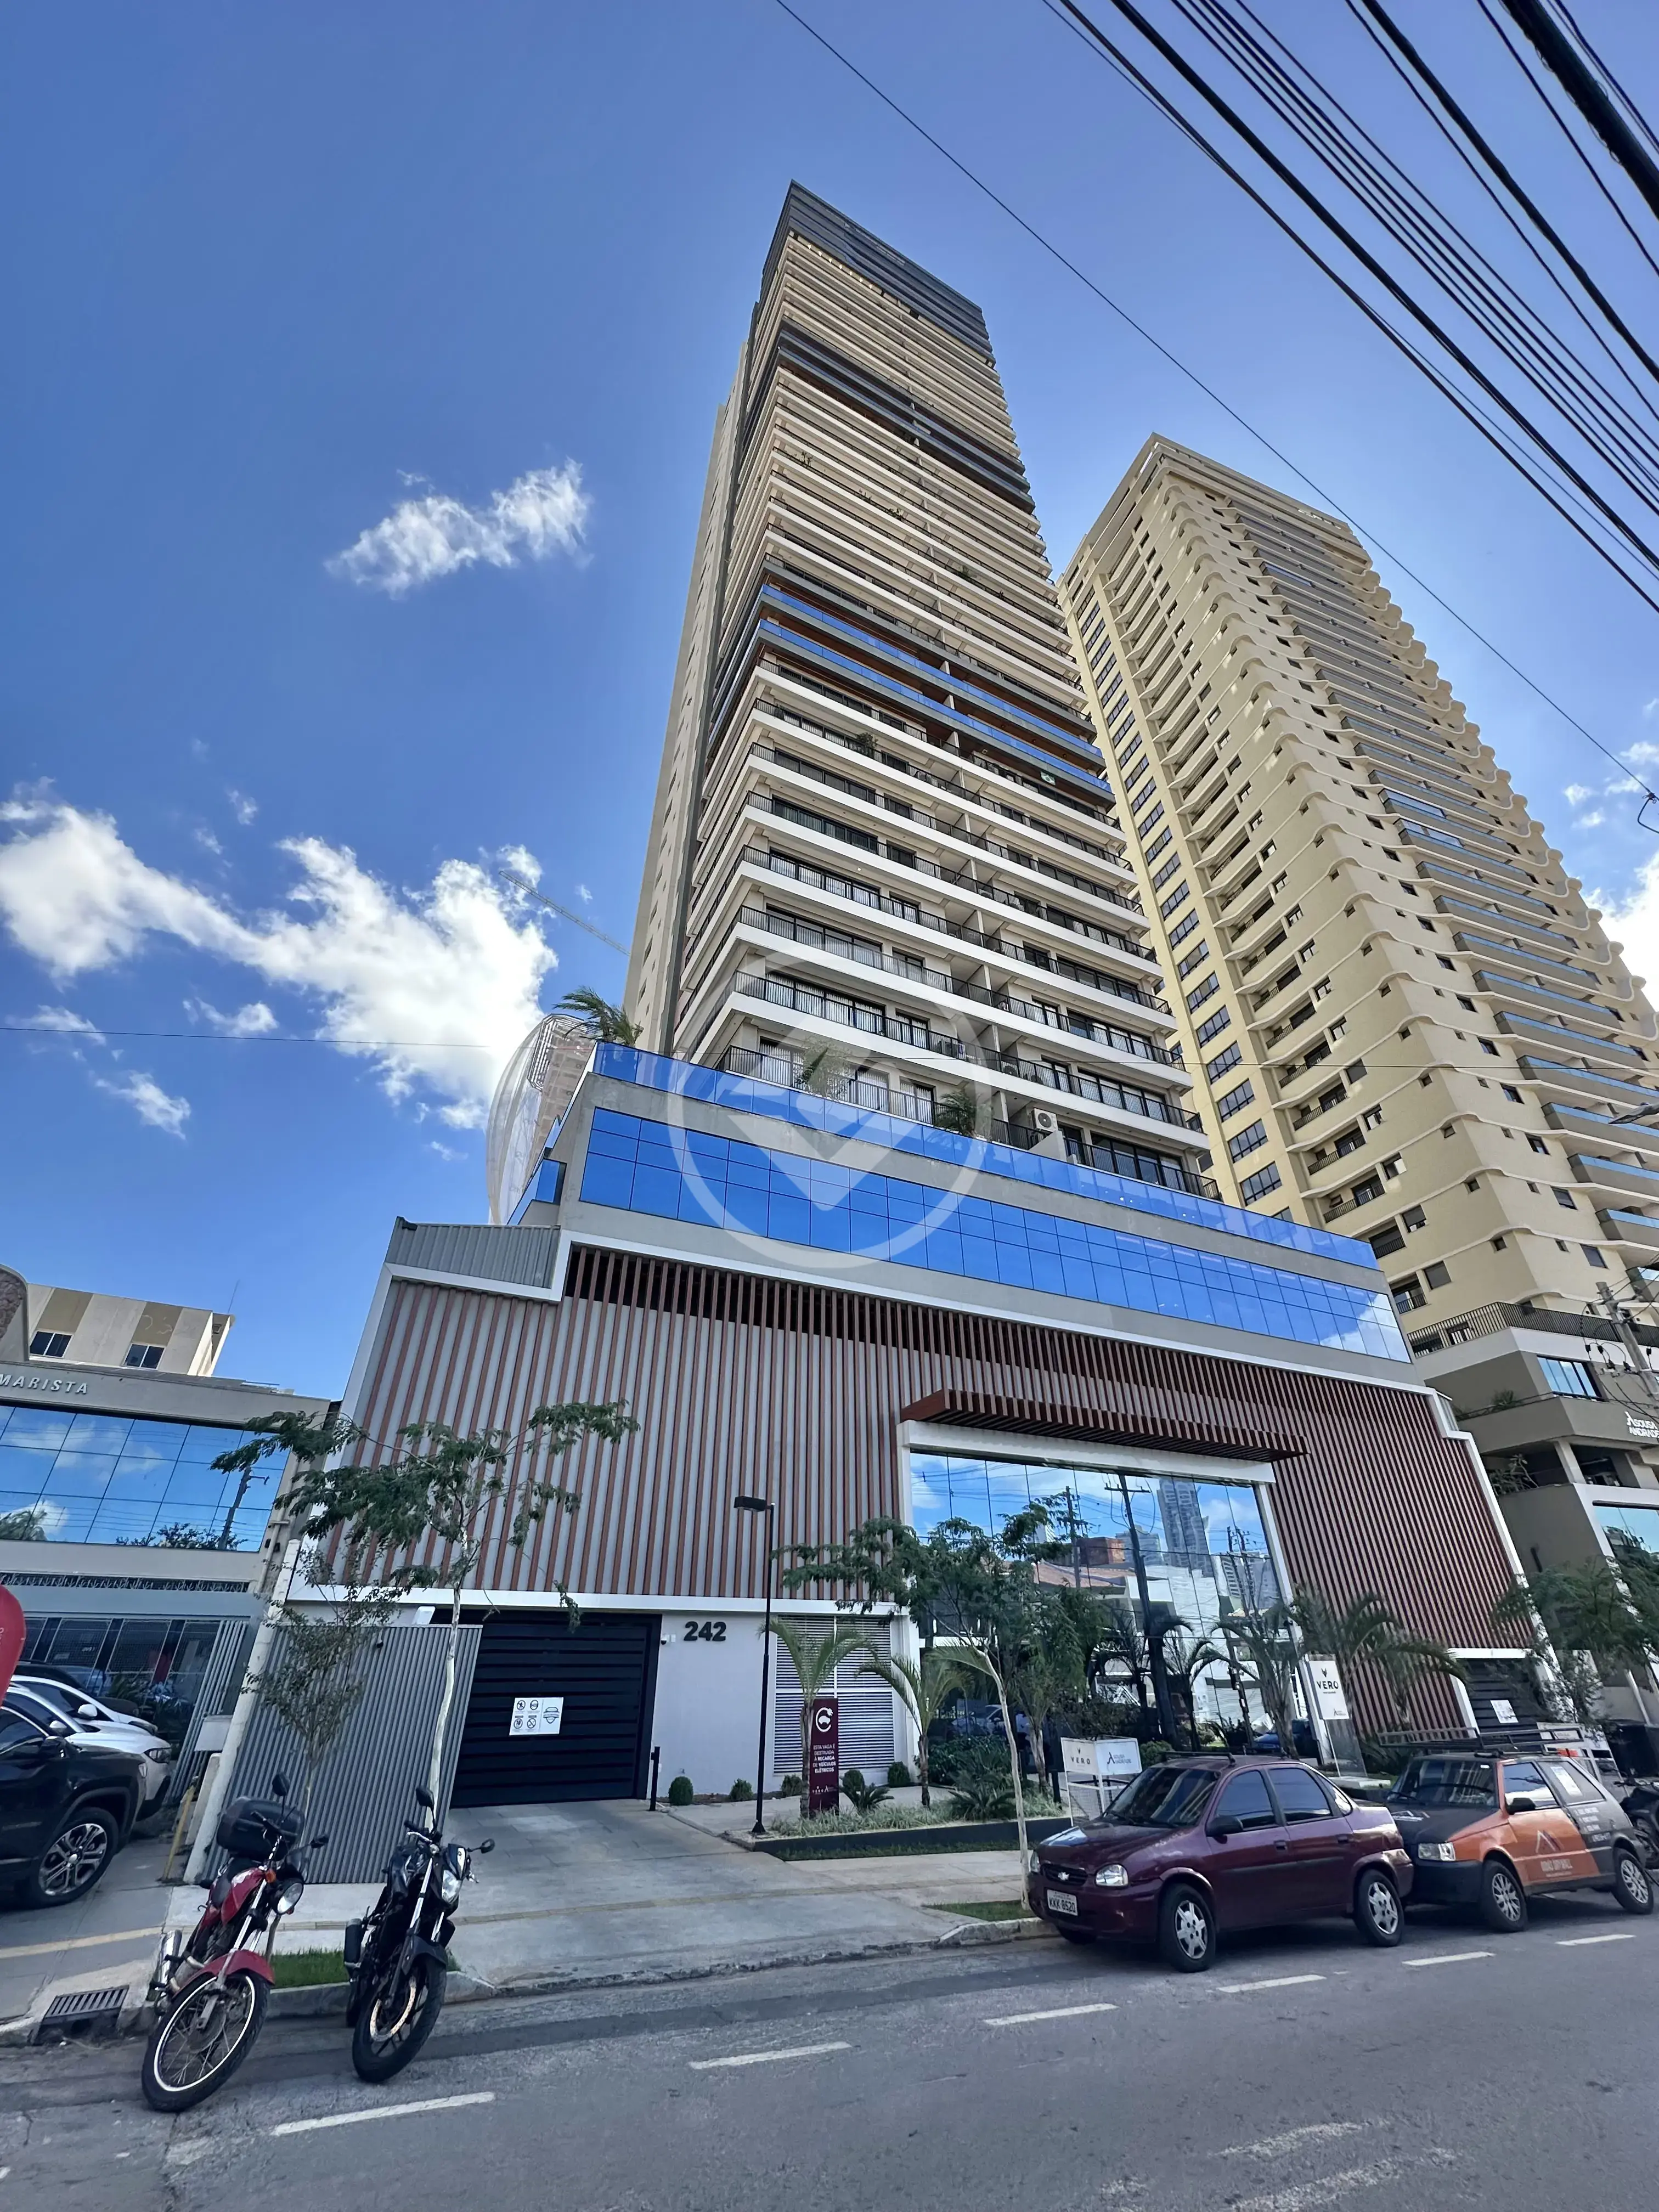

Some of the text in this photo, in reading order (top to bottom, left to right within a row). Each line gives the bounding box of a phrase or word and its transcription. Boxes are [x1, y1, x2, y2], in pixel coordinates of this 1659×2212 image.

[0, 1374, 88, 1395] MARISTA
[684, 1621, 726, 1641] 242
[1316, 1680, 1339, 1690] VERO
[1070, 1756, 1091, 1765] VERO
